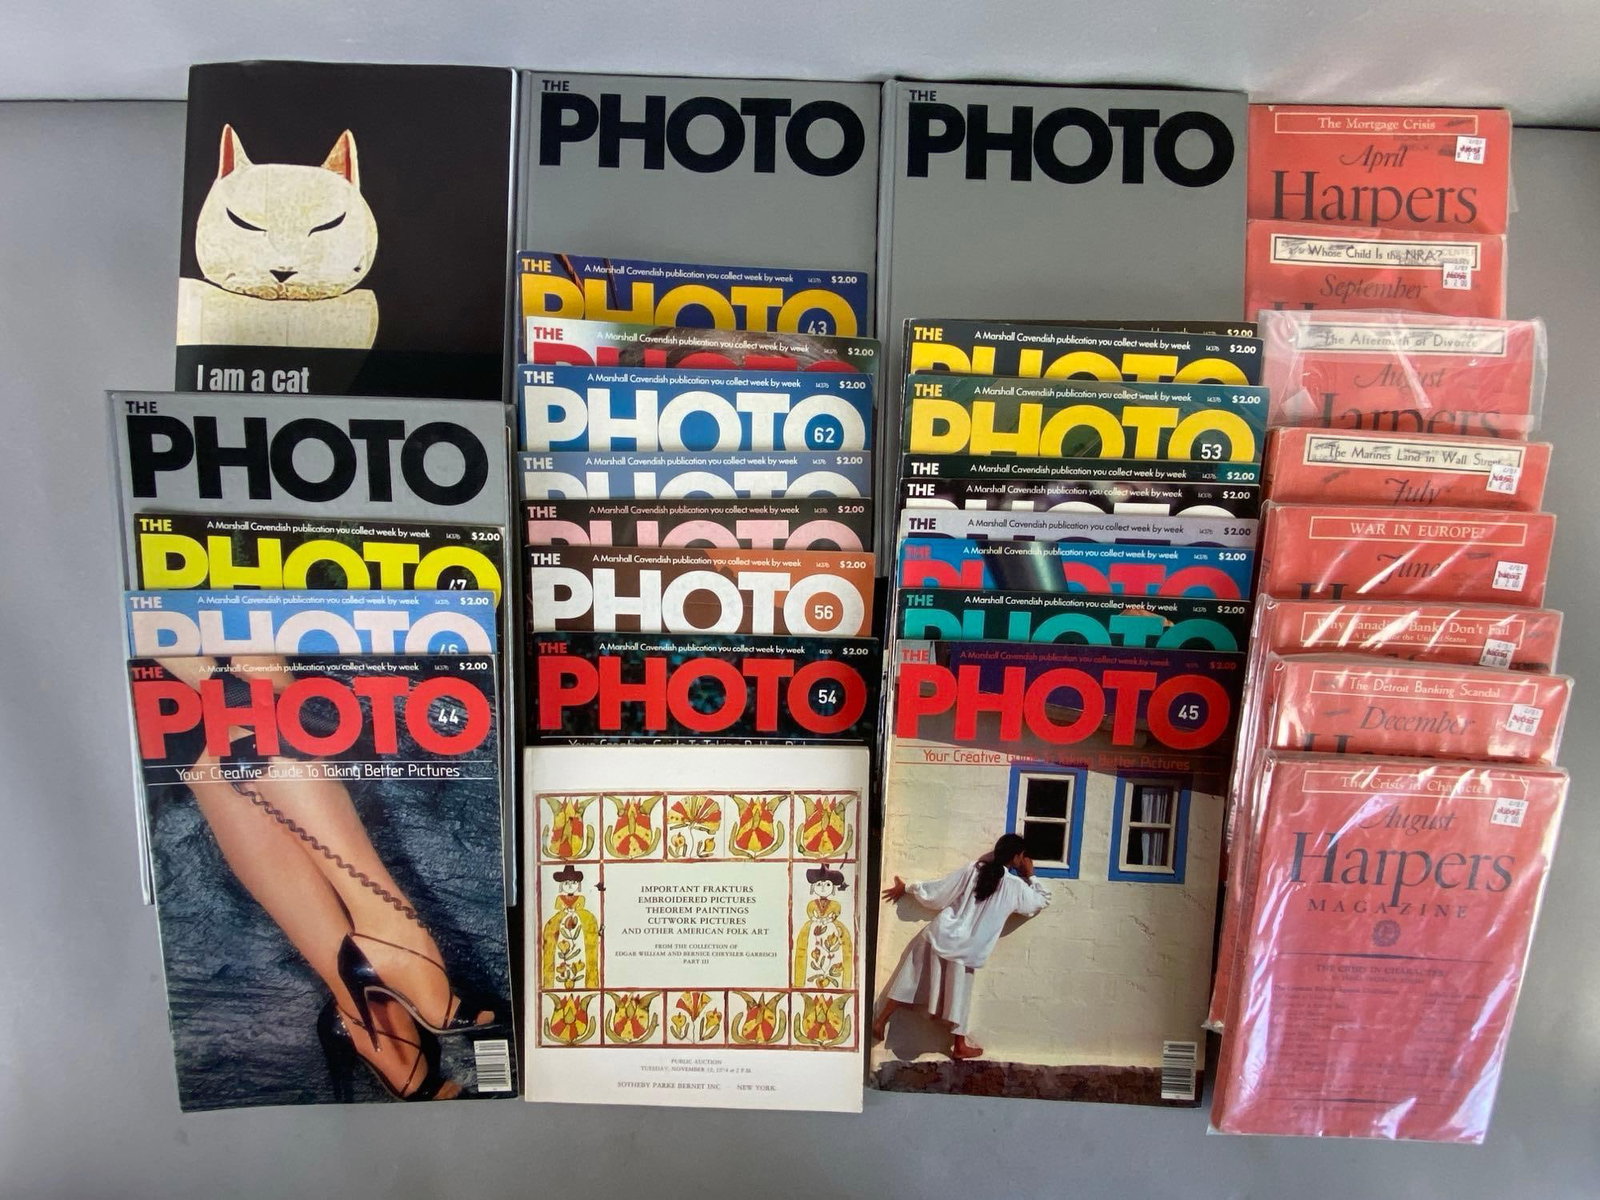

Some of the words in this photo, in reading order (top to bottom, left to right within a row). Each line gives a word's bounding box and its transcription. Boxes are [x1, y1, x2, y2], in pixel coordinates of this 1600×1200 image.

[542, 80, 570, 92] THE
[910, 90, 936, 101] THE
[540, 91, 865, 176] PHOTO
[1318, 118, 1342, 129] The
[1346, 118, 1399, 132] Mortgage
[1402, 120, 1436, 130] Crisis
[908, 102, 1234, 187] PHOTO
[1339, 145, 1408, 173] April
[1271, 170, 1477, 227] Harpers
[1307, 244, 1342, 258] Whose
[1346, 246, 1372, 260] Child
[1376, 248, 1383, 260] Is
[1387, 249, 1400, 260] the
[1405, 249, 1442, 260] NRA?
[522, 259, 551, 272] THE
[832, 276, 857, 284] $2.00
[1320, 273, 1428, 304] September
[521, 272, 857, 338] PHOTO
[808, 321, 827, 336] 43
[534, 326, 563, 340] THE
[848, 348, 874, 356] $2.00
[914, 327, 943, 341] THE
[1230, 345, 1256, 354] $2.00
[197, 364, 204, 390] I
[210, 367, 244, 391] am
[251, 368, 265, 392] a
[272, 365, 309, 393] cat
[524, 371, 554, 384] THE
[839, 381, 866, 390] $2.00
[915, 384, 942, 396] THE
[1232, 396, 1260, 404] $2.00
[126, 401, 157, 414] THE
[524, 386, 866, 454] PHOTO
[814, 427, 835, 443] 62
[910, 399, 1255, 462] PHOTO
[126, 415, 488, 506] PHOTO
[1201, 444, 1222, 459] 53
[1352, 446, 1391, 460] Marines
[1397, 448, 1420, 462] Land
[1426, 451, 1434, 462] in
[1442, 451, 1466, 464] Wall
[524, 457, 553, 470] THE
[836, 456, 863, 464] $2.00
[911, 462, 940, 475] THE
[1227, 472, 1254, 480] $2.00
[908, 484, 936, 496] THE
[1222, 492, 1250, 500] $2.00
[1385, 478, 1445, 504] July
[528, 506, 557, 518] THE
[838, 505, 864, 514] $2.00
[140, 518, 172, 532] THE
[216, 521, 248, 530] Marshall
[250, 522, 291, 532] Cavendish
[292, 524, 334, 533] publication
[336, 526, 350, 534] you
[351, 526, 374, 536] collect
[376, 528, 396, 537] week
[398, 528, 408, 538] by
[410, 530, 430, 538] week
[472, 532, 500, 541] $2.00
[909, 518, 936, 530] THE
[1224, 528, 1251, 536] $2.00
[1350, 522, 1386, 535] WAR
[1394, 524, 1410, 536] IN
[140, 533, 502, 591] PHOTO
[532, 553, 560, 566] THE
[840, 561, 866, 569] $2.00
[1218, 553, 1246, 561] $2.00
[1377, 554, 1440, 584] June
[130, 596, 162, 608] THE
[532, 567, 865, 635] PHOTO
[907, 594, 934, 606] THE
[1217, 606, 1245, 614] $2.00
[814, 605, 834, 620] 56
[1450, 622, 1482, 634] Don't
[539, 642, 568, 654] THE
[903, 649, 929, 662] THE
[131, 667, 164, 680] THE
[460, 662, 488, 670] $2.00
[538, 655, 868, 734] PHOTO
[818, 690, 837, 704] 54
[1350, 677, 1370, 690] The
[1373, 679, 1408, 693] Detroit
[1414, 682, 1455, 698] Banking
[1460, 684, 1500, 698] Scandal
[438, 708, 459, 724] 44
[896, 663, 1230, 750] PHOTO
[1178, 704, 1200, 720] 45
[133, 676, 491, 759] PHOTO
[1360, 706, 1476, 735] December
[176, 768, 205, 782] Your
[210, 766, 262, 780] Creative
[308, 764, 318, 777] To
[324, 764, 360, 780] Taking
[364, 764, 404, 777] Better
[408, 764, 460, 776] Pictures
[1360, 805, 1456, 836] August
[1282, 832, 1516, 907] Harpers
[1308, 898, 1468, 918] MAGAZINE
